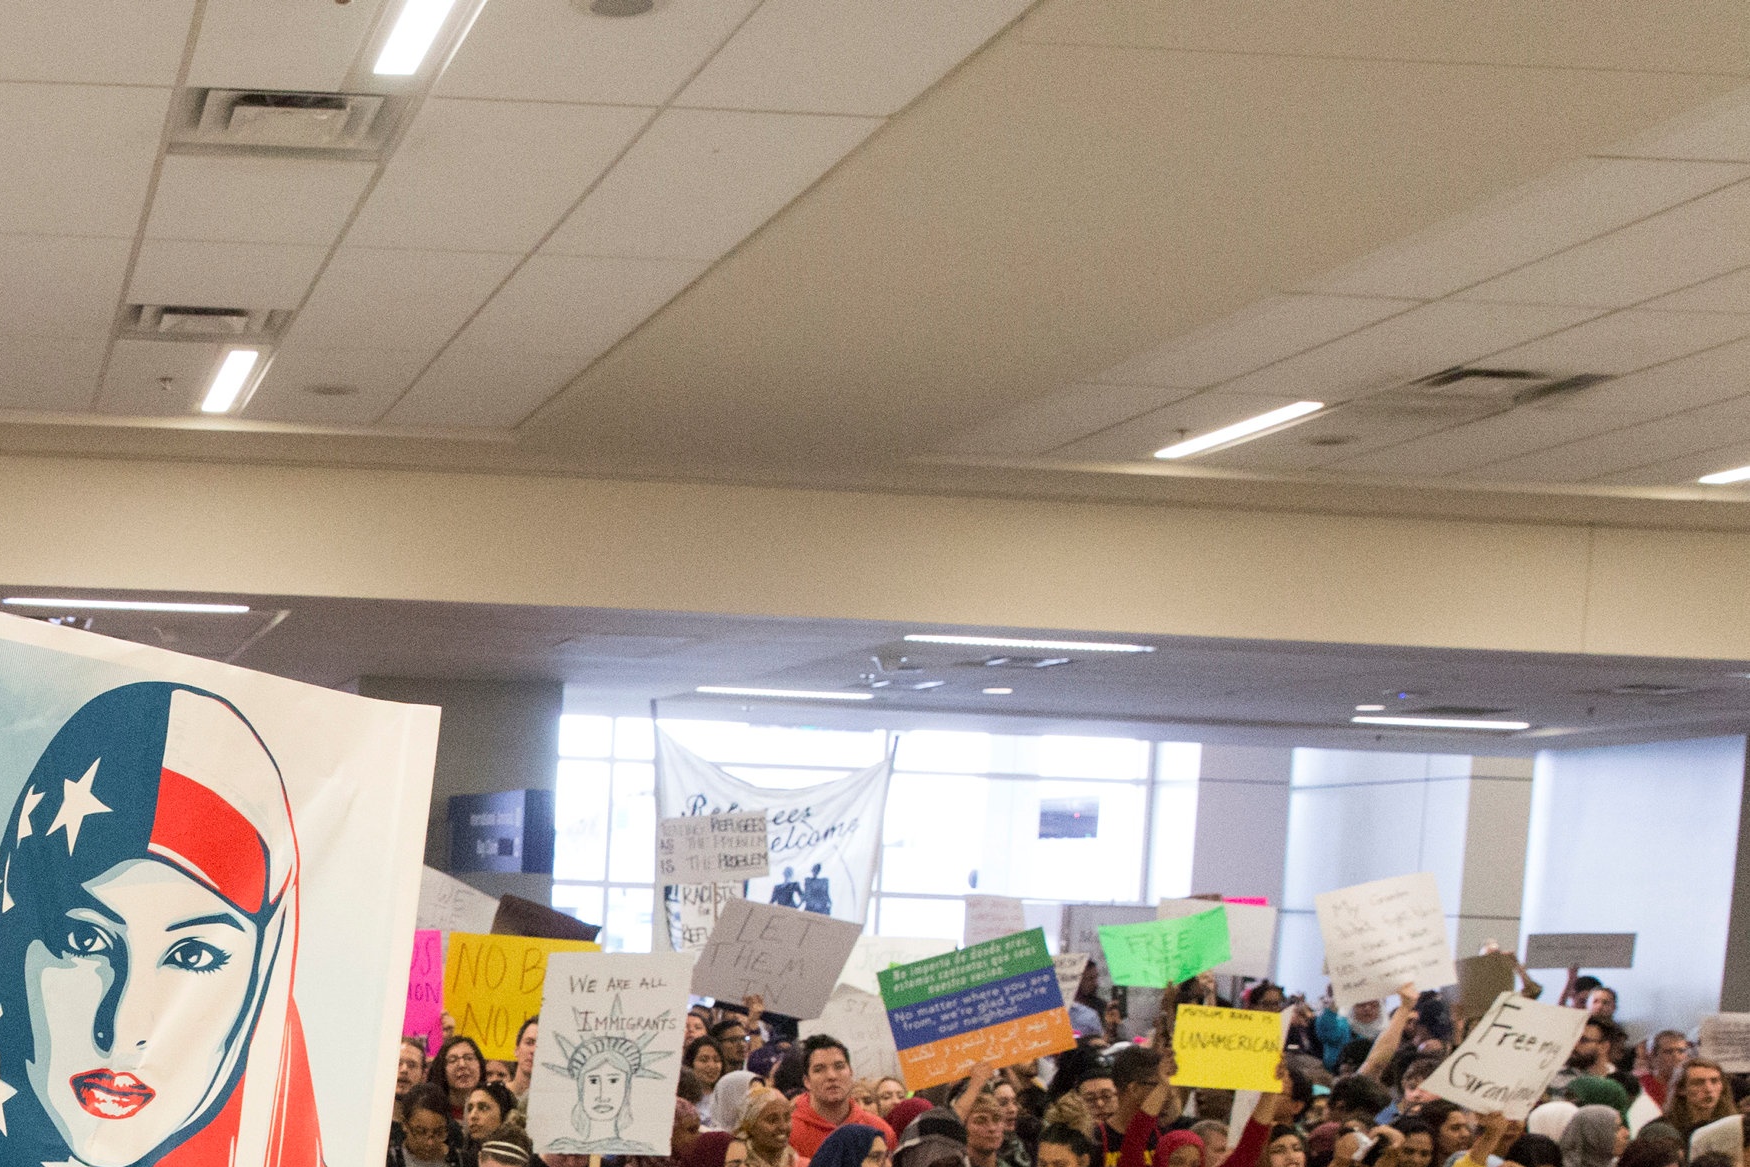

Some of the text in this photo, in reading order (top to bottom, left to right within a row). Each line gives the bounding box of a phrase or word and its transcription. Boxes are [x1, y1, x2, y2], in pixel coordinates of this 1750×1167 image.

[769, 816, 860, 853] elcome
[735, 907, 830, 949] LET
[1124, 928, 1193, 956] FREE
[451, 942, 508, 996] NO
[709, 942, 806, 978] THEM
[569, 974, 668, 994] WE ARE ALL
[894, 973, 1051, 1024] No matter where you are
[577, 1010, 677, 1032] IMMIGRANTS
[939, 1005, 973, 1022] we're
[977, 996, 1006, 1015] glad
[1009, 985, 1048, 1006] you're
[456, 1002, 510, 1049] NO
[937, 1021, 959, 1034] our
[1476, 1001, 1539, 1053] Free
